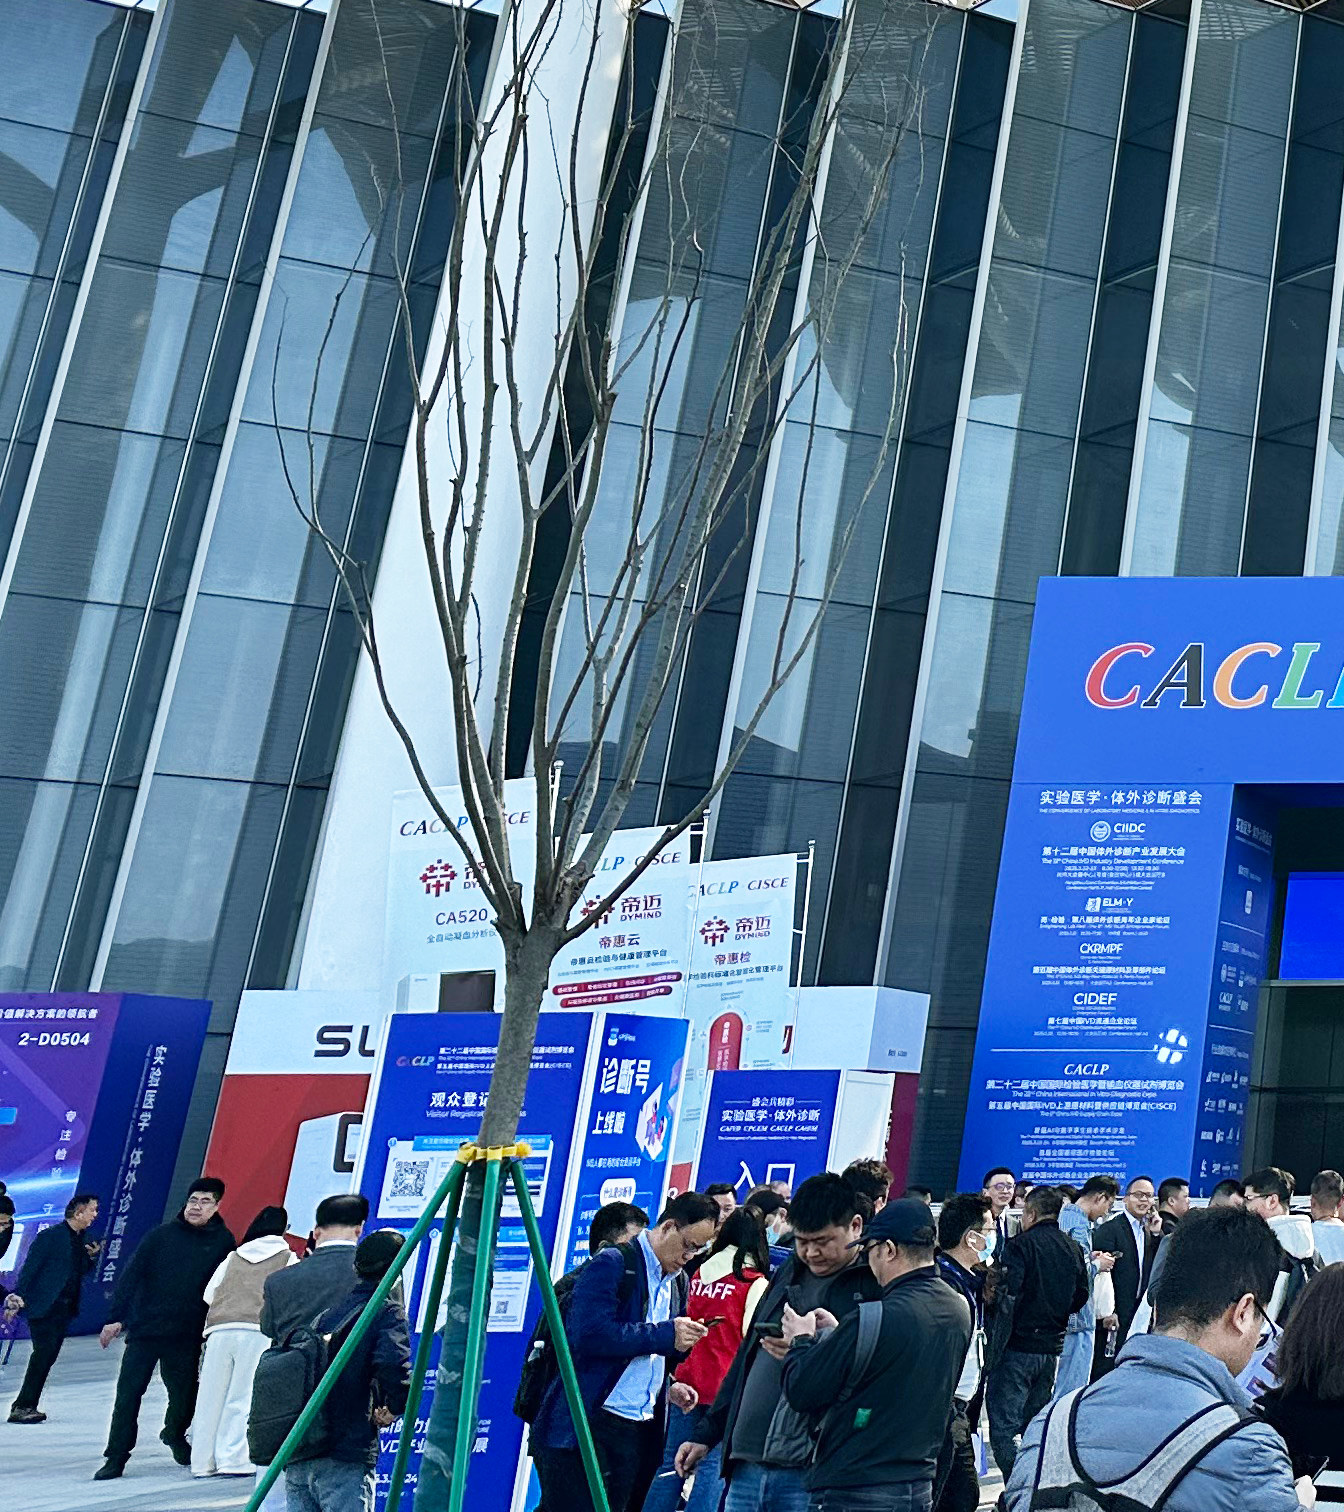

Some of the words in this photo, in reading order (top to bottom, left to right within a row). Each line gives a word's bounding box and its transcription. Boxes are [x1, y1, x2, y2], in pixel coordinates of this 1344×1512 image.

[1040, 790, 1203, 806] 实验医学·体外诊断盛会
[400, 816, 469, 836] CACP
[634, 851, 682, 868] CSCE
[748, 877, 790, 891] CISCE
[621, 894, 662, 914] 帝迈
[436, 908, 488, 926] CA520
[620, 911, 662, 922] DYMIND
[735, 915, 772, 933] 帝迈
[1080, 943, 1124, 955] CKRMPF
[1073, 993, 1118, 1005] CIDEF
[18, 1032, 90, 1046] 2-D0504
[600, 1057, 651, 1095] 诊断号
[1063, 1063, 1110, 1076] CACLP
[722, 1109, 820, 1122] 实验医学·体外诊断
[734, 1160, 796, 1191] 入口
[691, 1278, 735, 1300] STAFF
